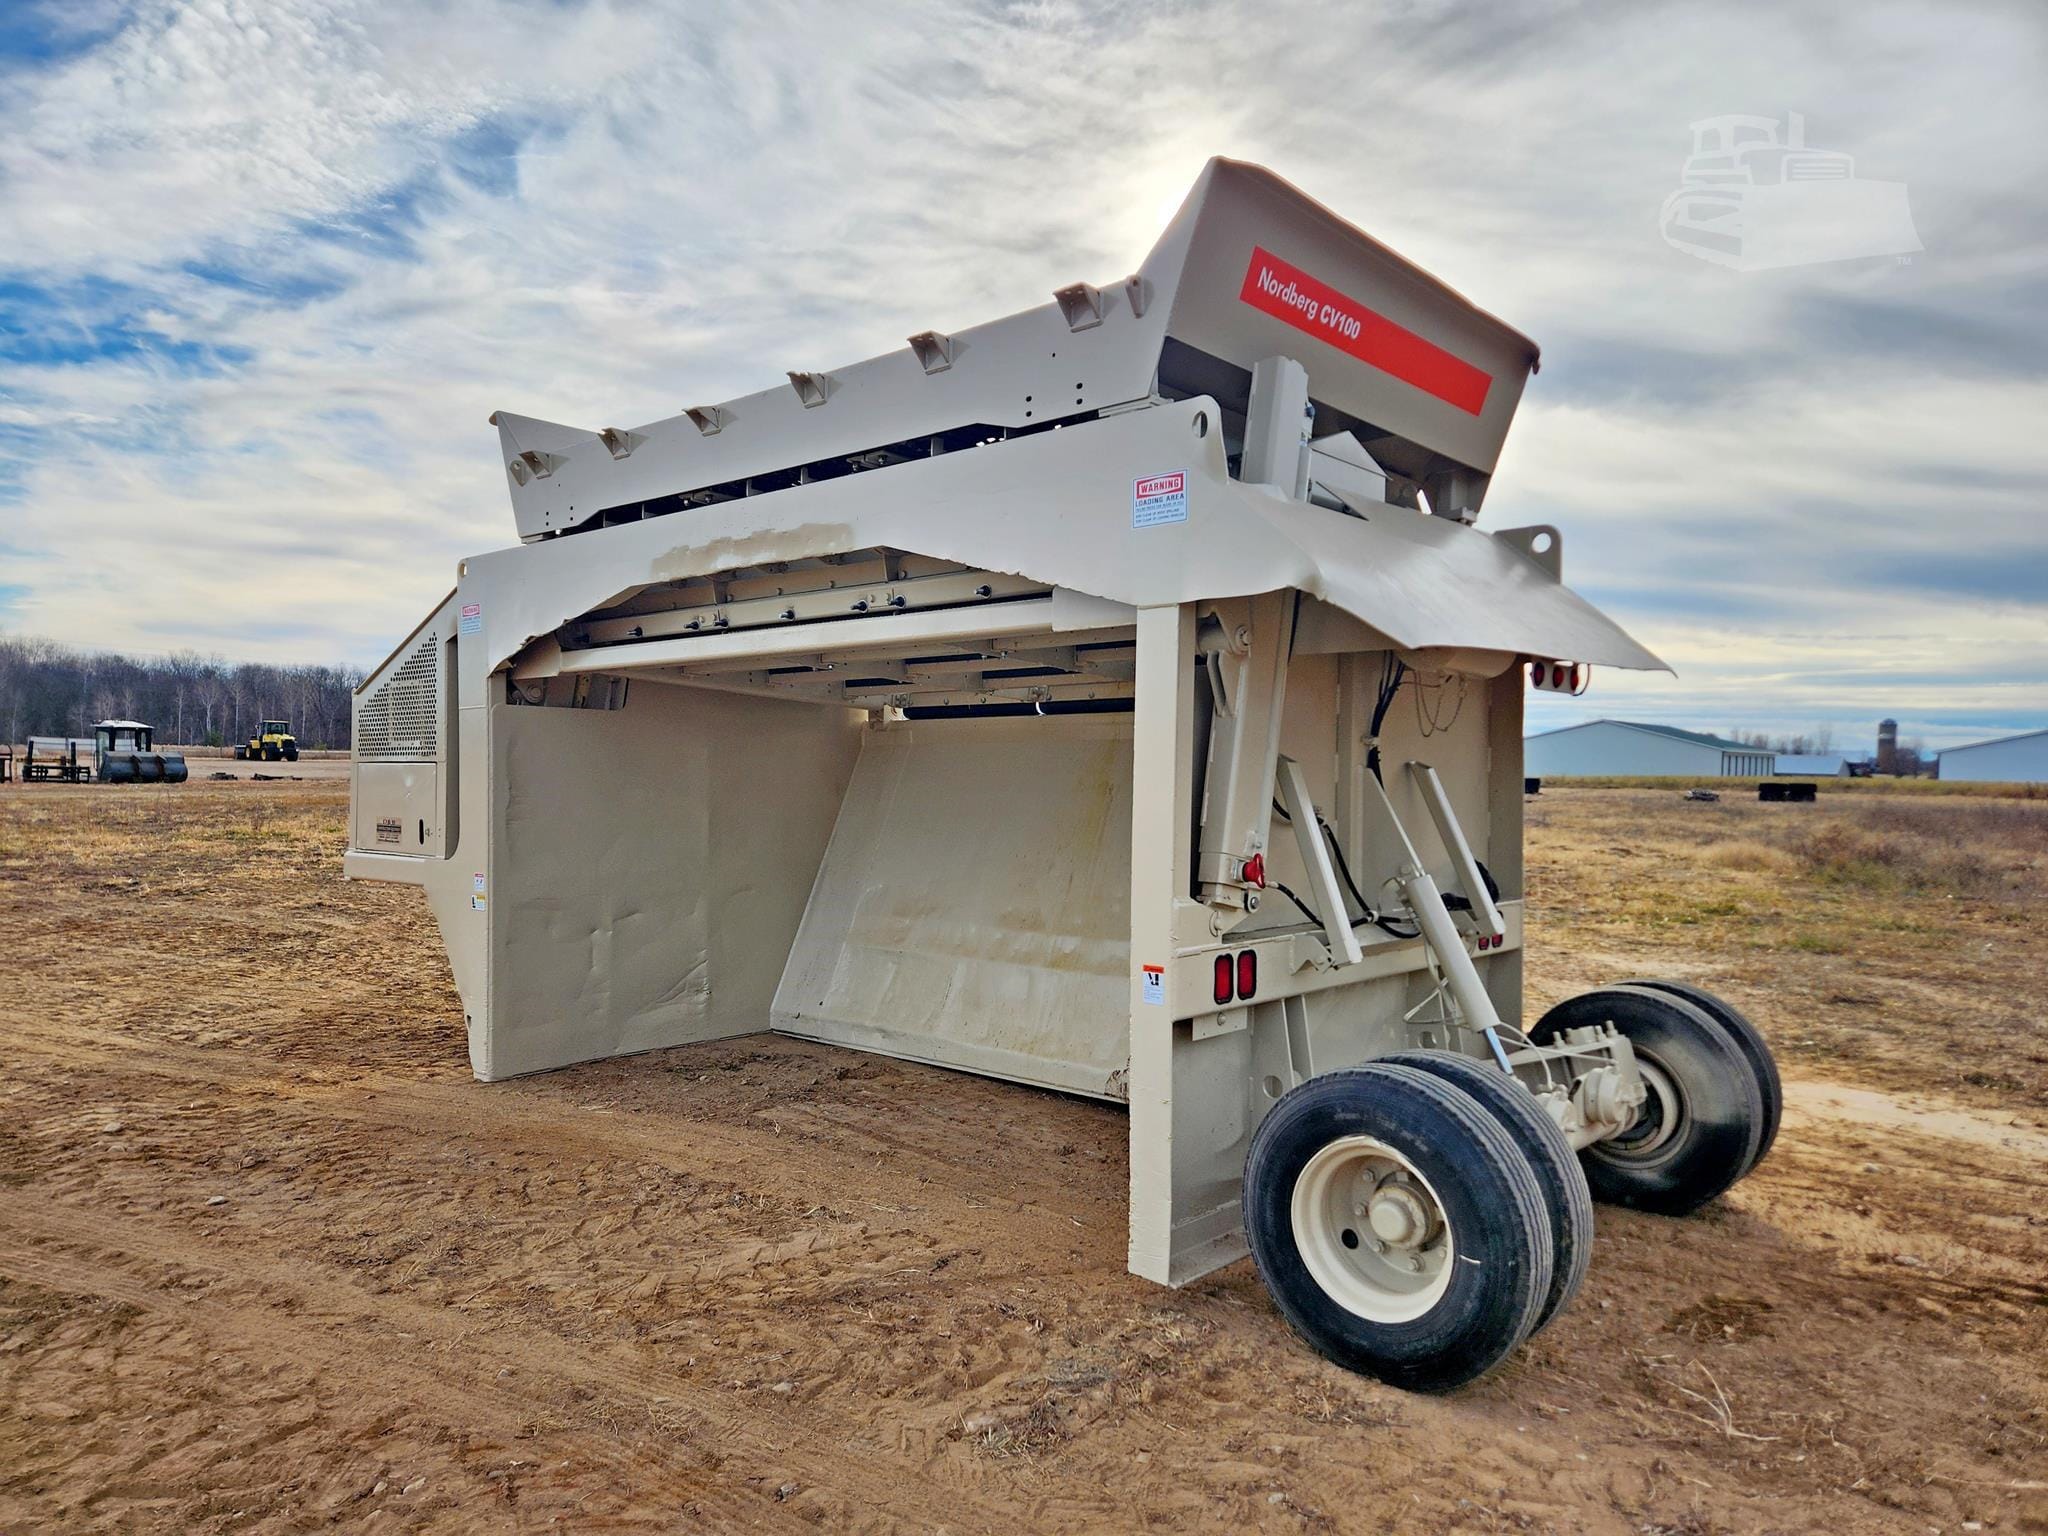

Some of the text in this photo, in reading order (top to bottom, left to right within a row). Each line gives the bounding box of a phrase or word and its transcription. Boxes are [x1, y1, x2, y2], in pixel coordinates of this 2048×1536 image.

[1257, 266, 1361, 340] Nordberg CV100
[1141, 479, 1179, 493] WARNING
[1135, 496, 1164, 508] LOADING
[1166, 493, 1185, 502] AREA
